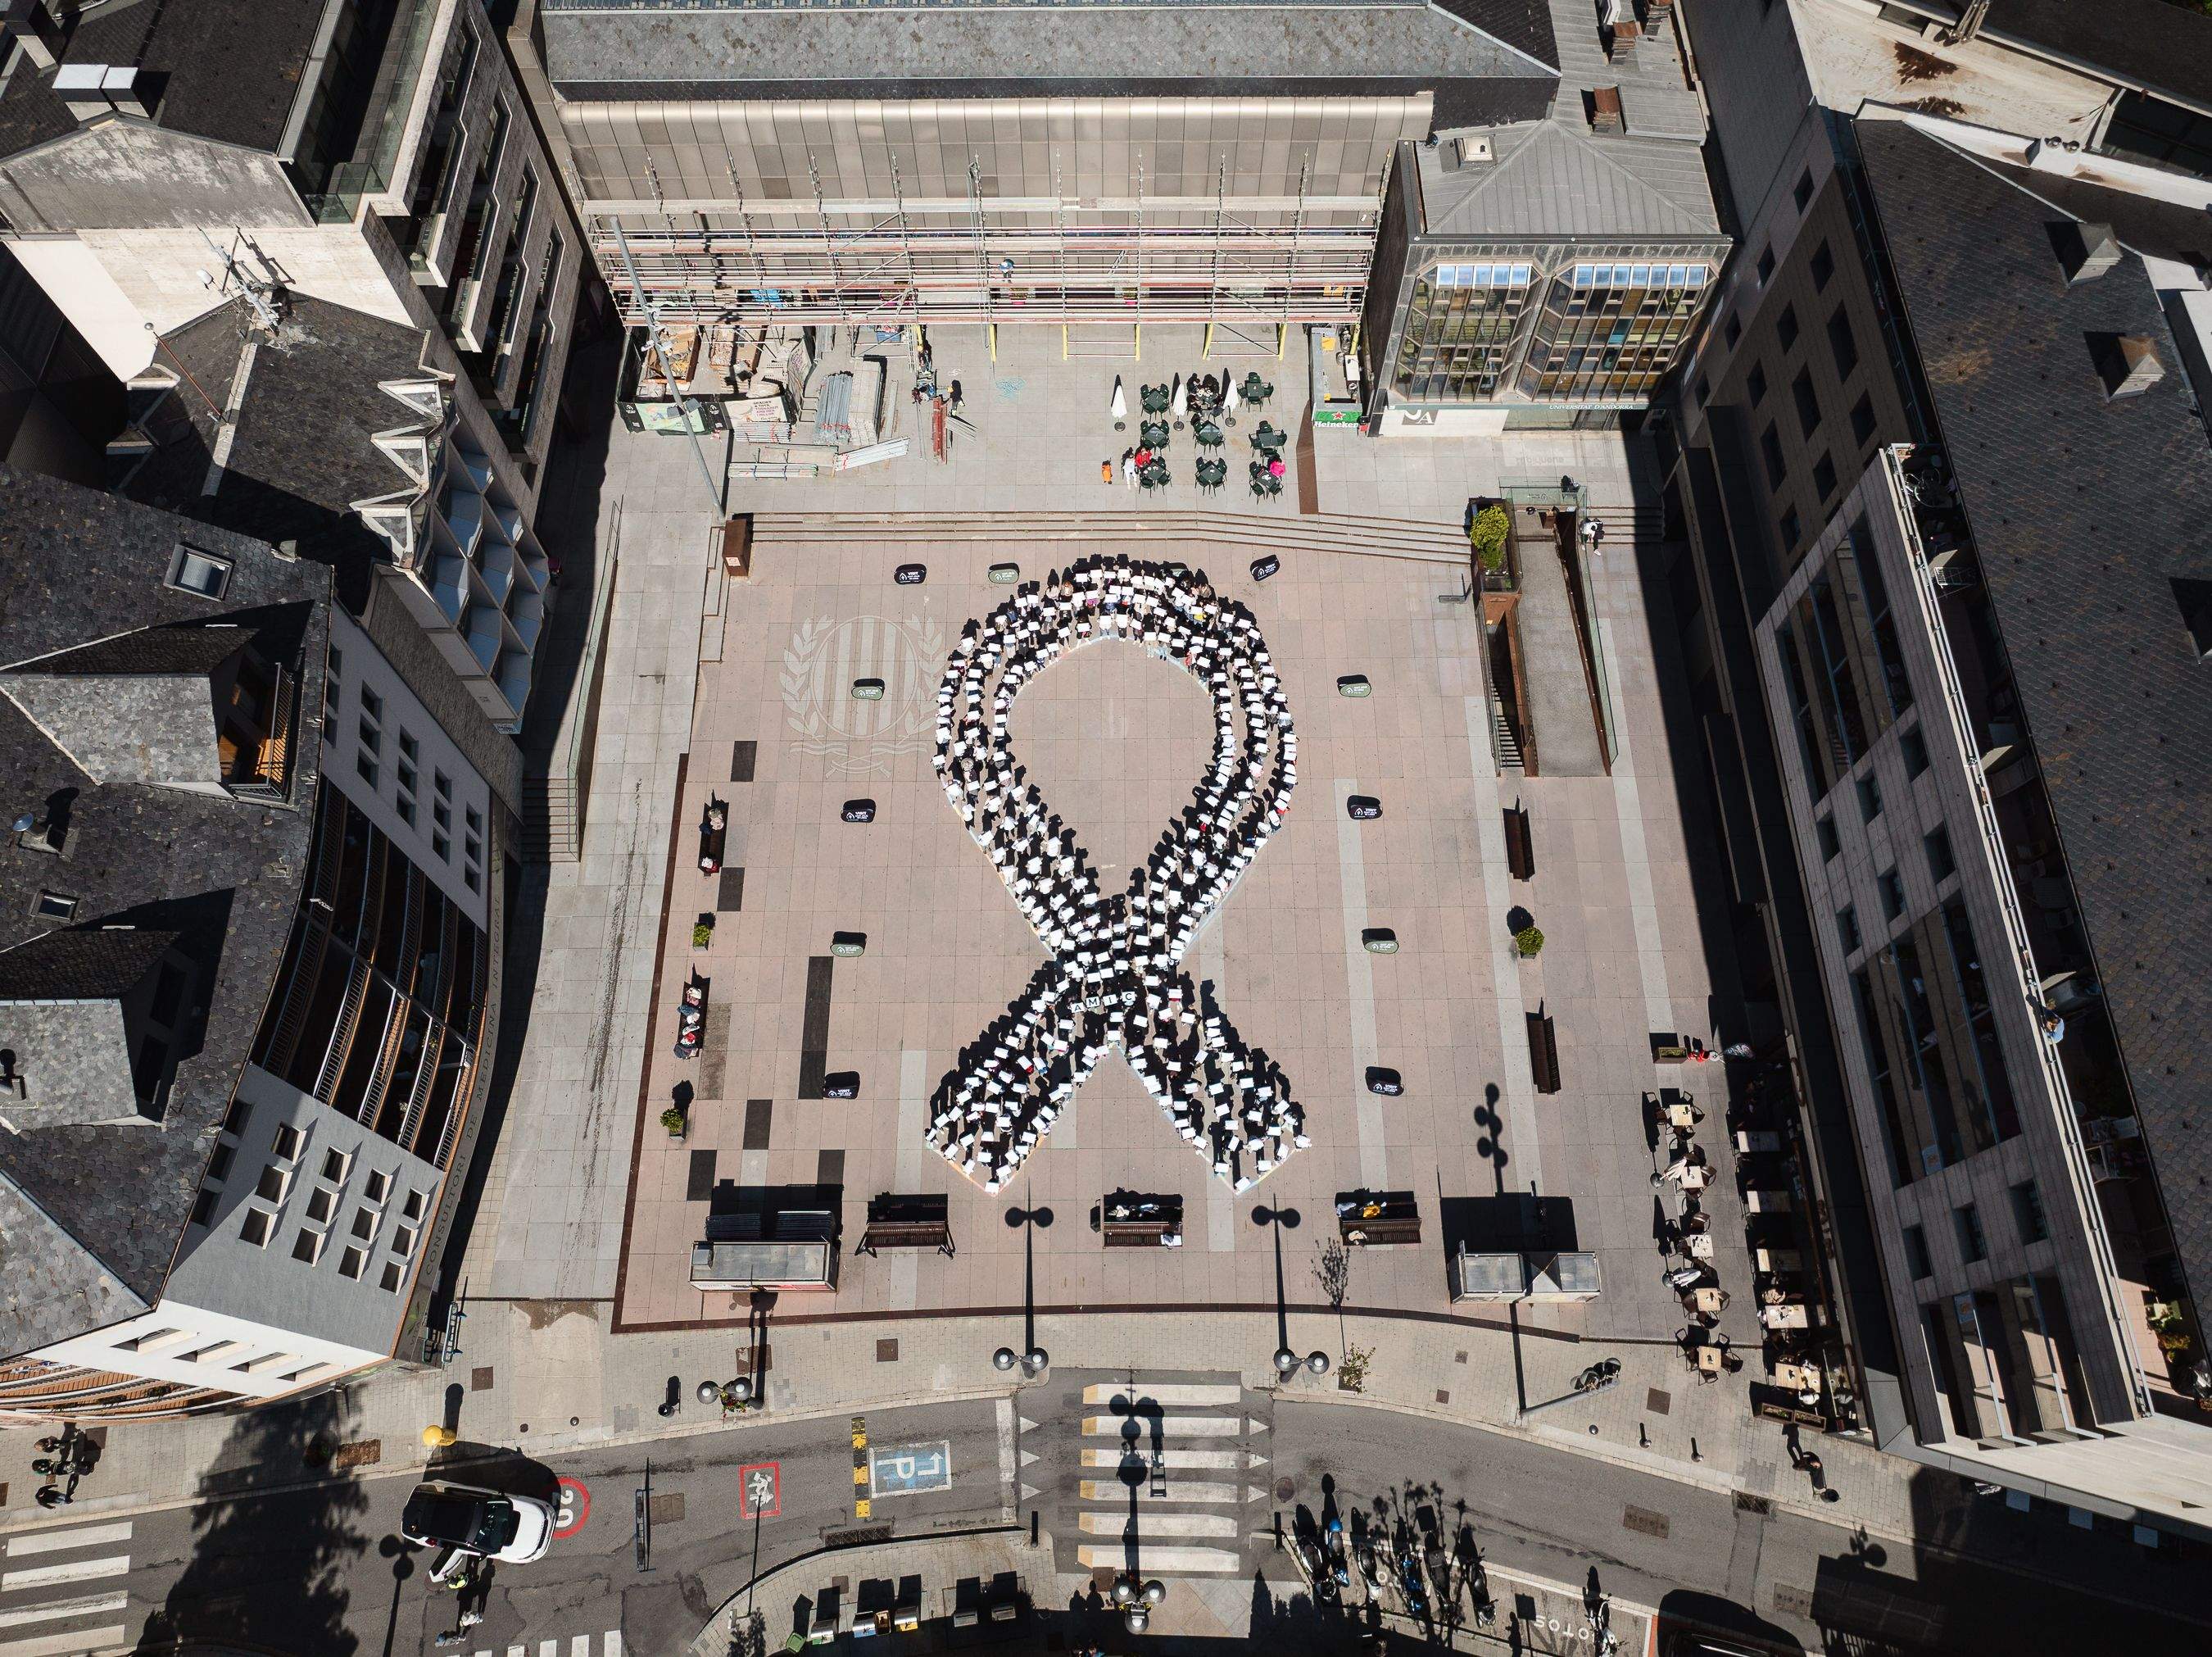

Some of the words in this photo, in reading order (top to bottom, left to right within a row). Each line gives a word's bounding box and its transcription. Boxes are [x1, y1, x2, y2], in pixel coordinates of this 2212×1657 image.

[425, 1153, 465, 1276] CONSULTORI
[467, 1115, 478, 1141] DE
[478, 1002, 496, 1102] MEDICINA
[492, 897, 501, 988] INTEGRAL
[552, 1490, 573, 1528] 20
[1534, 1614, 1594, 1641] OTOS
